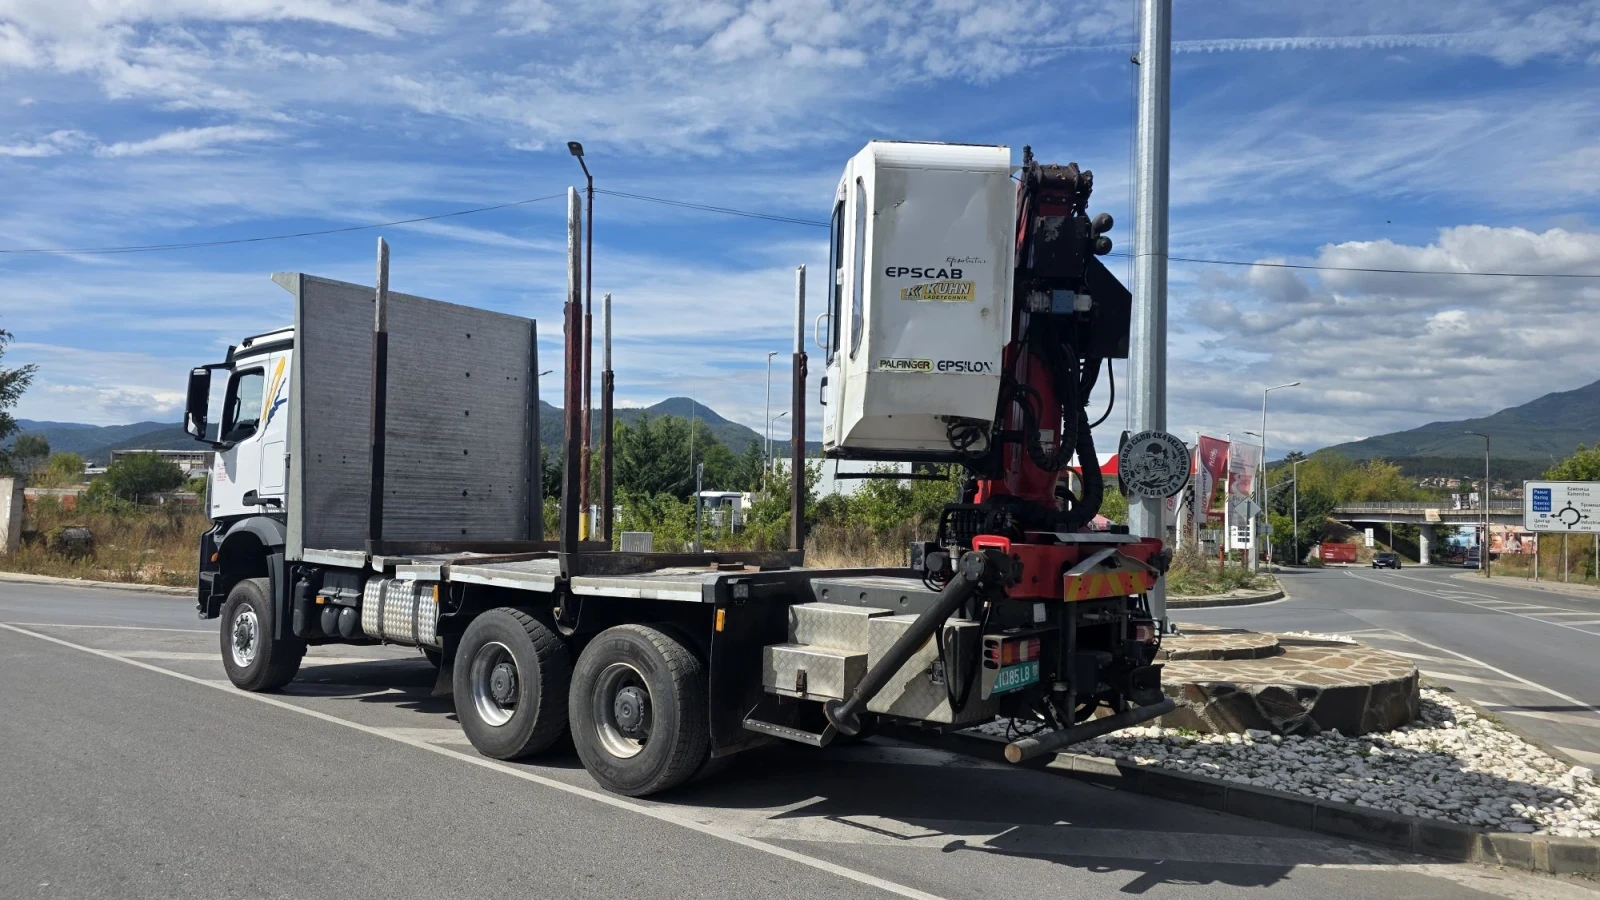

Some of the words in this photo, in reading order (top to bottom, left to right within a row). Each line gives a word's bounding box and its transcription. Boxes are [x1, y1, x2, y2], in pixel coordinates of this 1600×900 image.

[885, 266, 963, 279] EPSCAB
[926, 282, 970, 294] KUHN
[880, 360, 930, 369] PALFINGER
[1152, 432, 1167, 440] 4X4
[1167, 437, 1187, 476] VELINGRAD
[1131, 482, 1178, 496] BULGARIA
